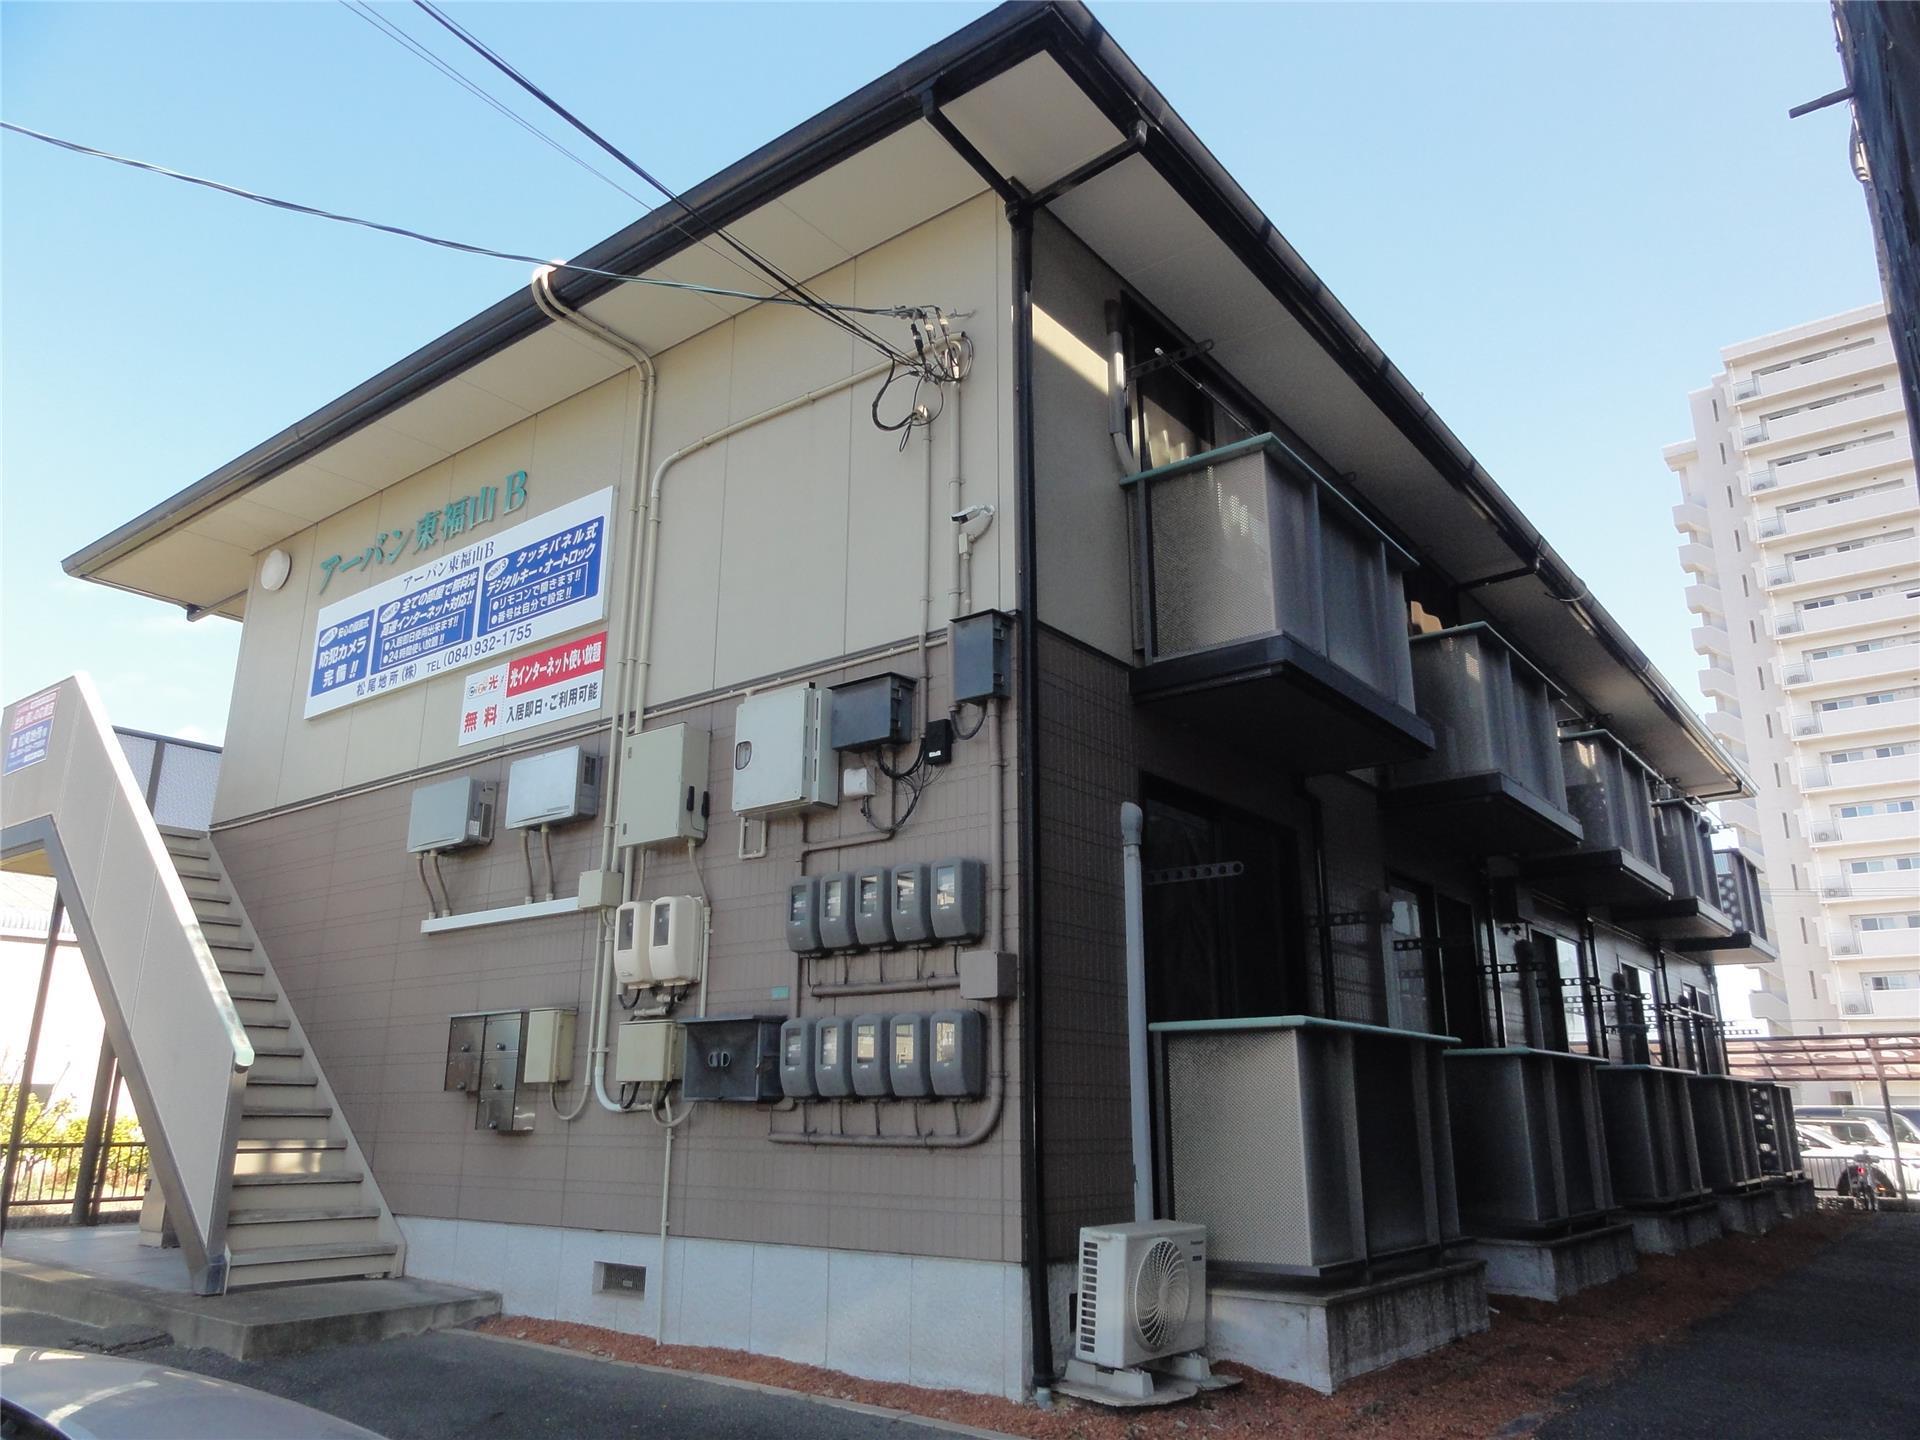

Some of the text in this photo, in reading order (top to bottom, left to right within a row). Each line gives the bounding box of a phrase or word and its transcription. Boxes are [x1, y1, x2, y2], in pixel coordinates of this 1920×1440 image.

[517, 522, 599, 567] タッチパネル式
[486, 543, 597, 597] デジタルキー・オートロック
[319, 635, 367, 669] 防犯カメラ
[426, 660, 440, 674] TEL
[444, 623, 532, 668] (084)932-1755
[509, 641, 602, 689] 光インターネット使い放題
[464, 704, 497, 733] 無料
[506, 681, 599, 724] 入居即日・ご利用可能
